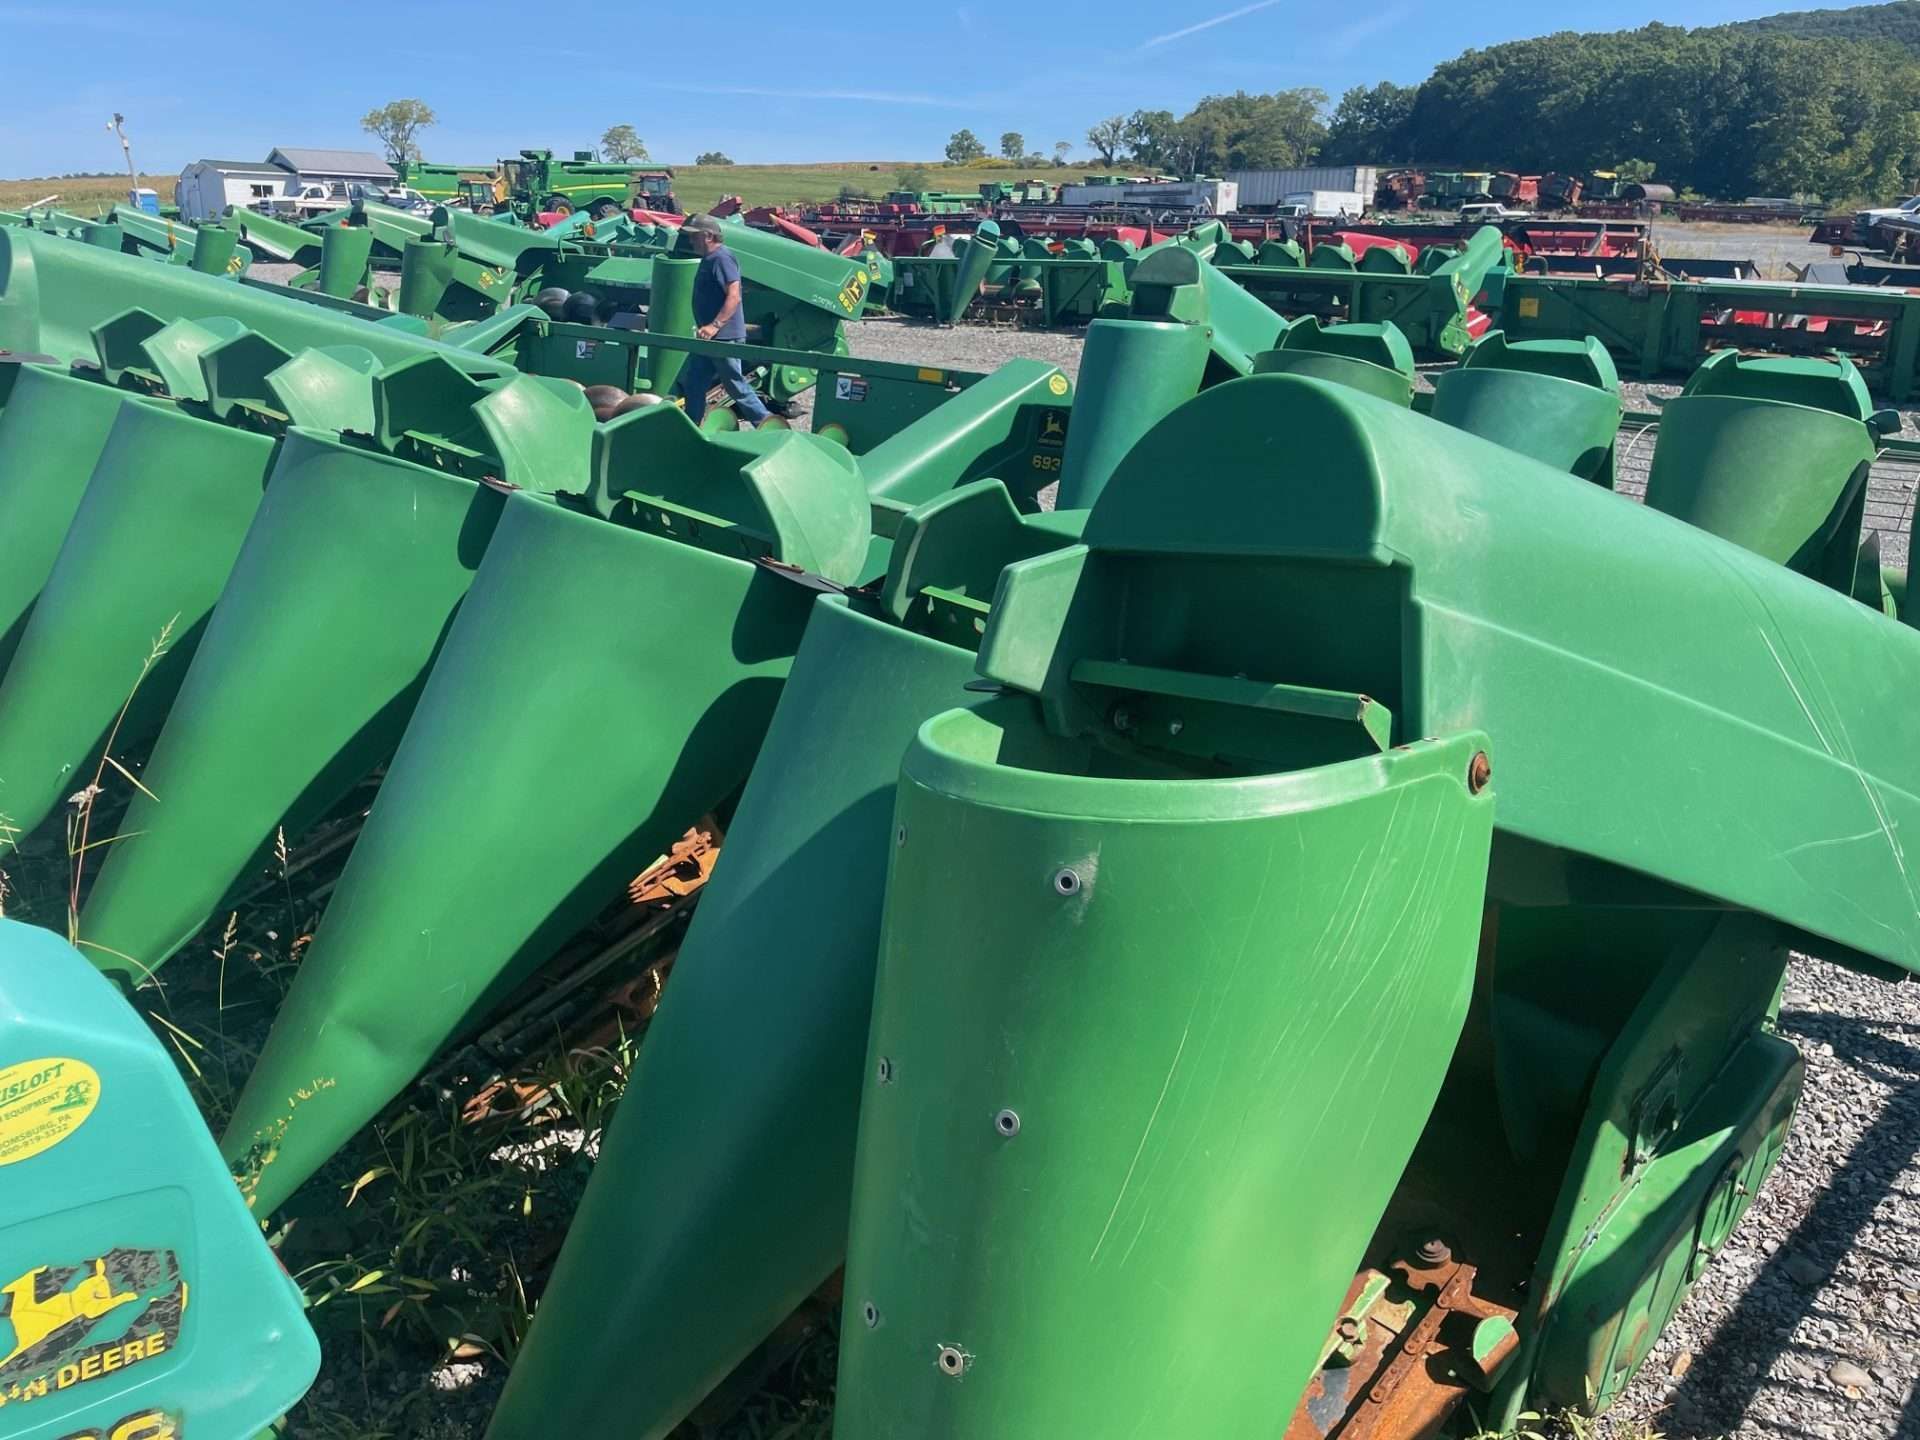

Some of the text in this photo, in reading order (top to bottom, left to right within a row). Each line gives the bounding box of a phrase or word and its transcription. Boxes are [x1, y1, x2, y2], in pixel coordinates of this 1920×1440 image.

[4, 1091, 60, 1121] EQUIPMENT
[58, 1113, 72, 1124] PA
[57, 1331, 166, 1389] DEERE
